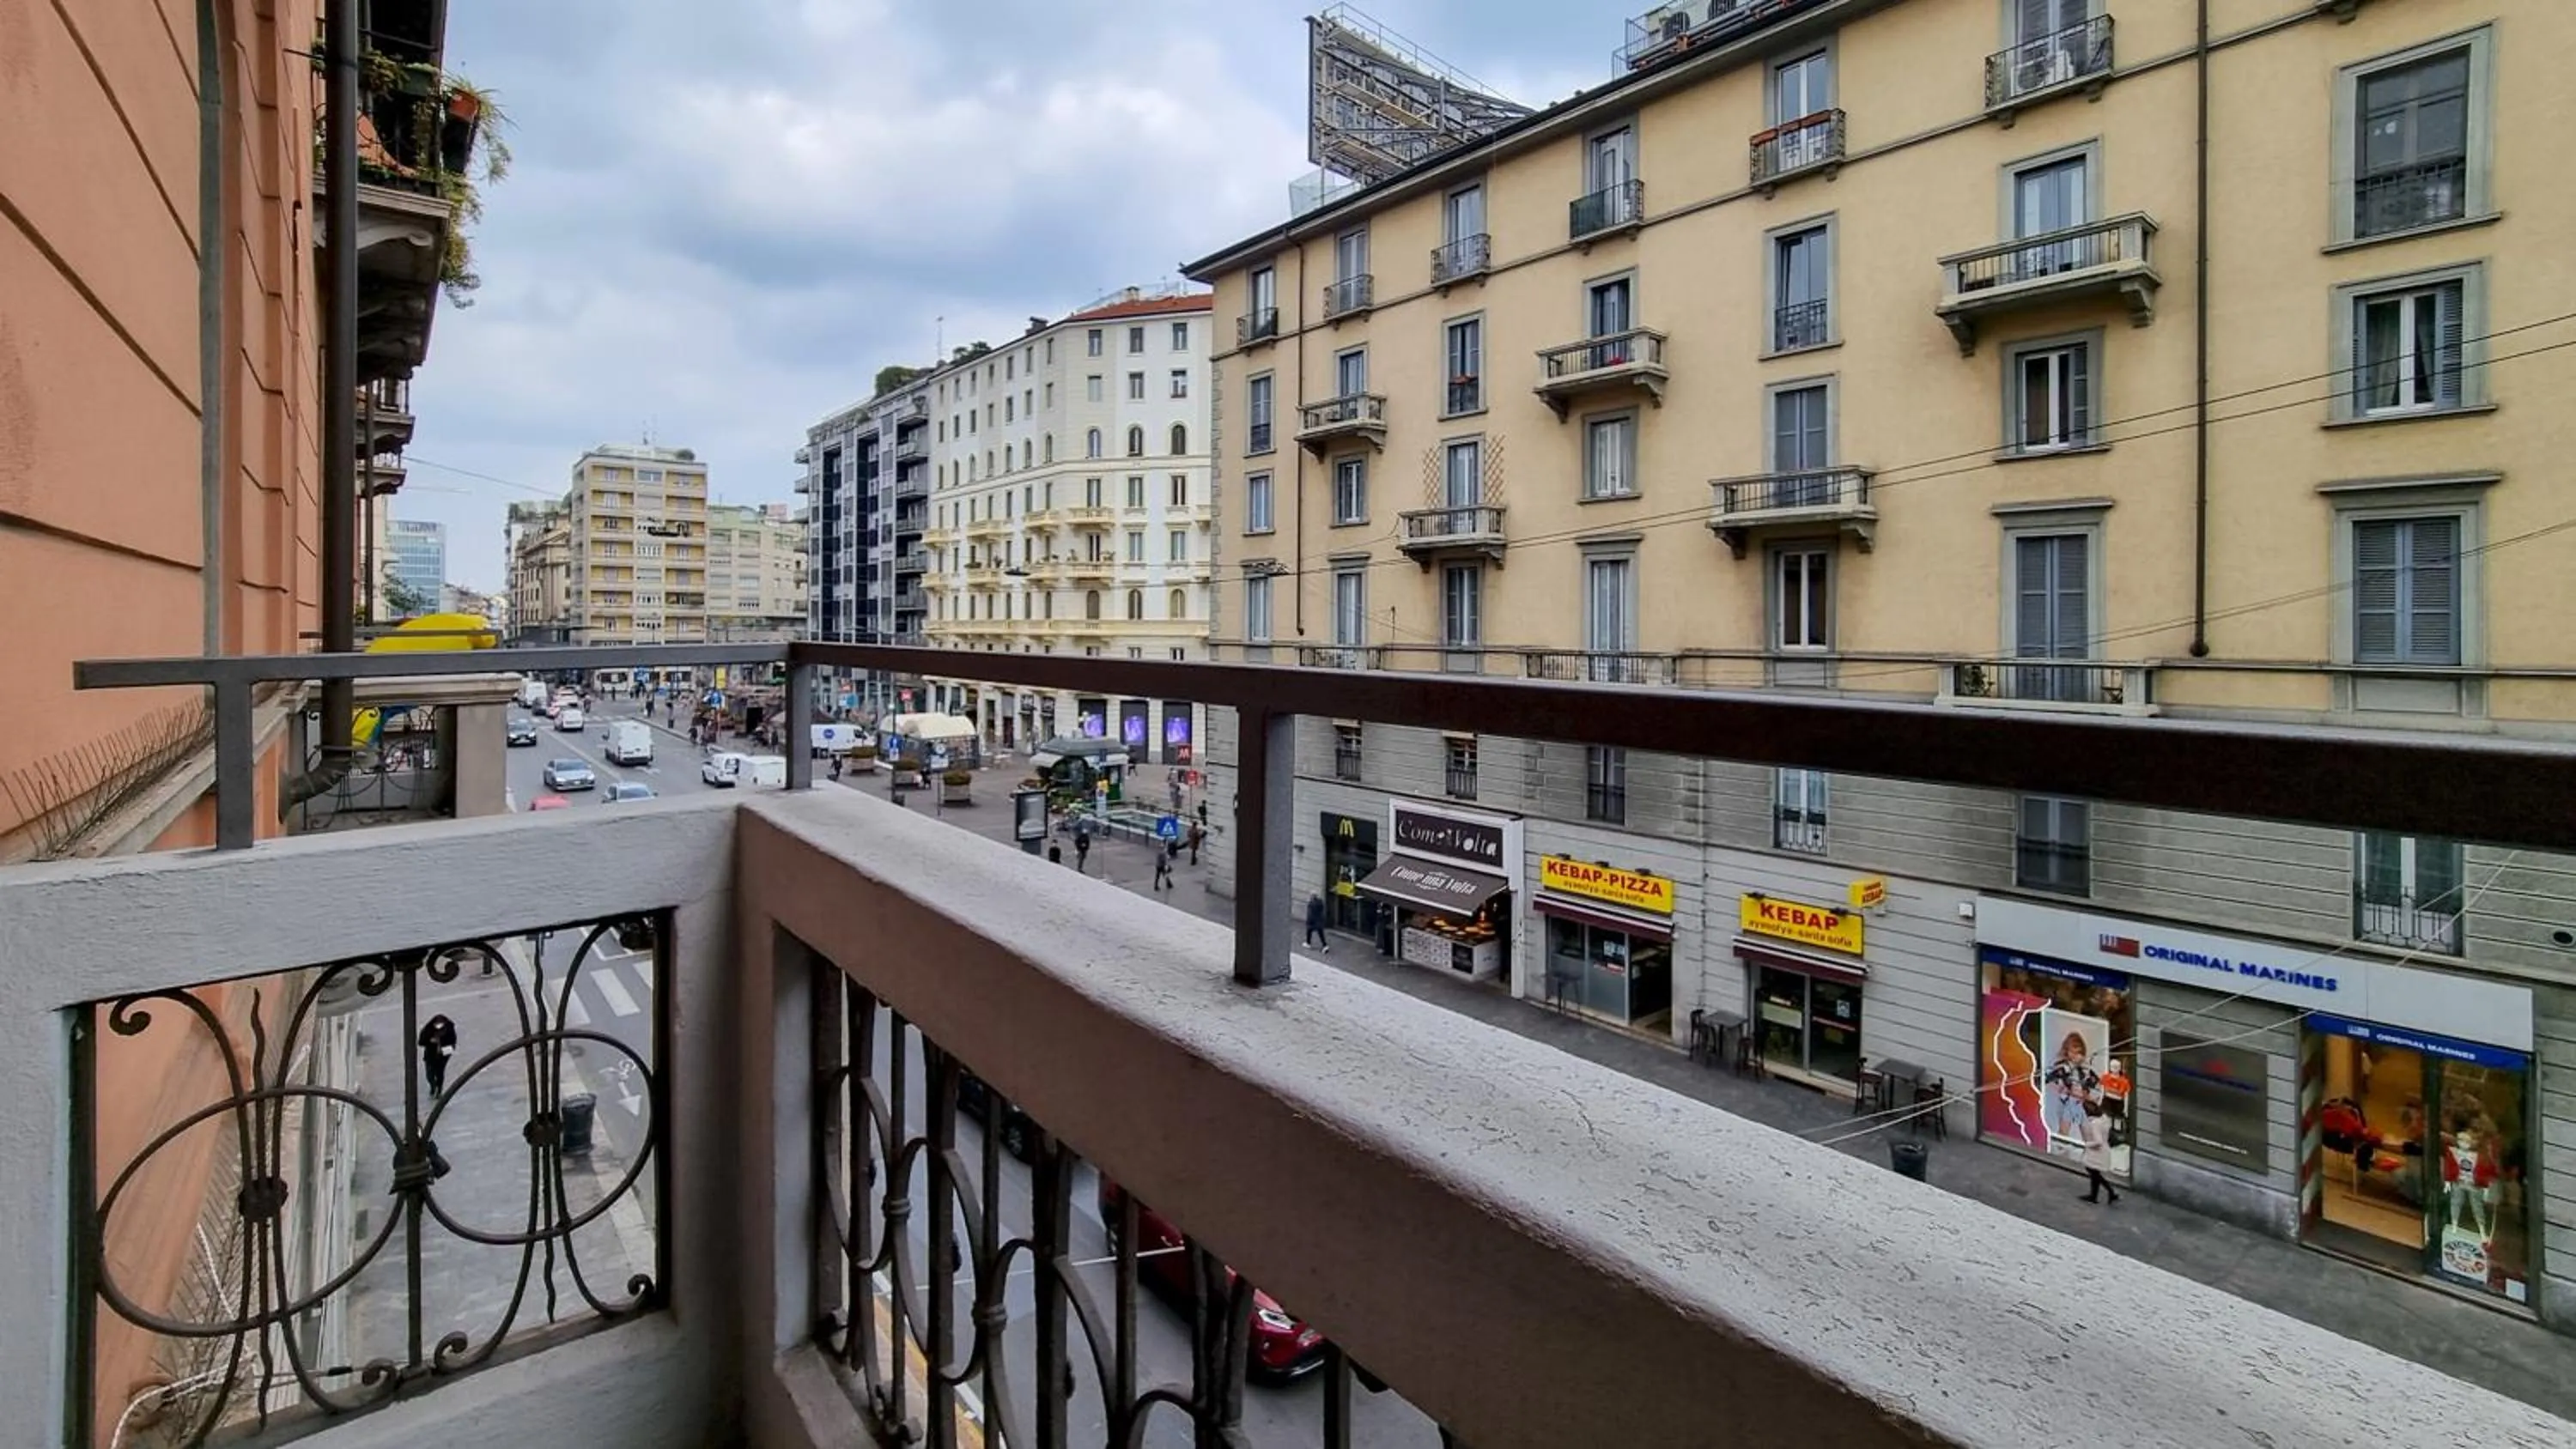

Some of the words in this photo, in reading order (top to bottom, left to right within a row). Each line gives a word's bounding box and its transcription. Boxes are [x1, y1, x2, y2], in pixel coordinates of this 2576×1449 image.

[1546, 859, 1663, 898] KEBAP-PIZZA
[1759, 902, 1839, 932] KEBAP
[2143, 944, 2234, 973] ORIGINAL
[2239, 961, 2338, 992] MARINES
